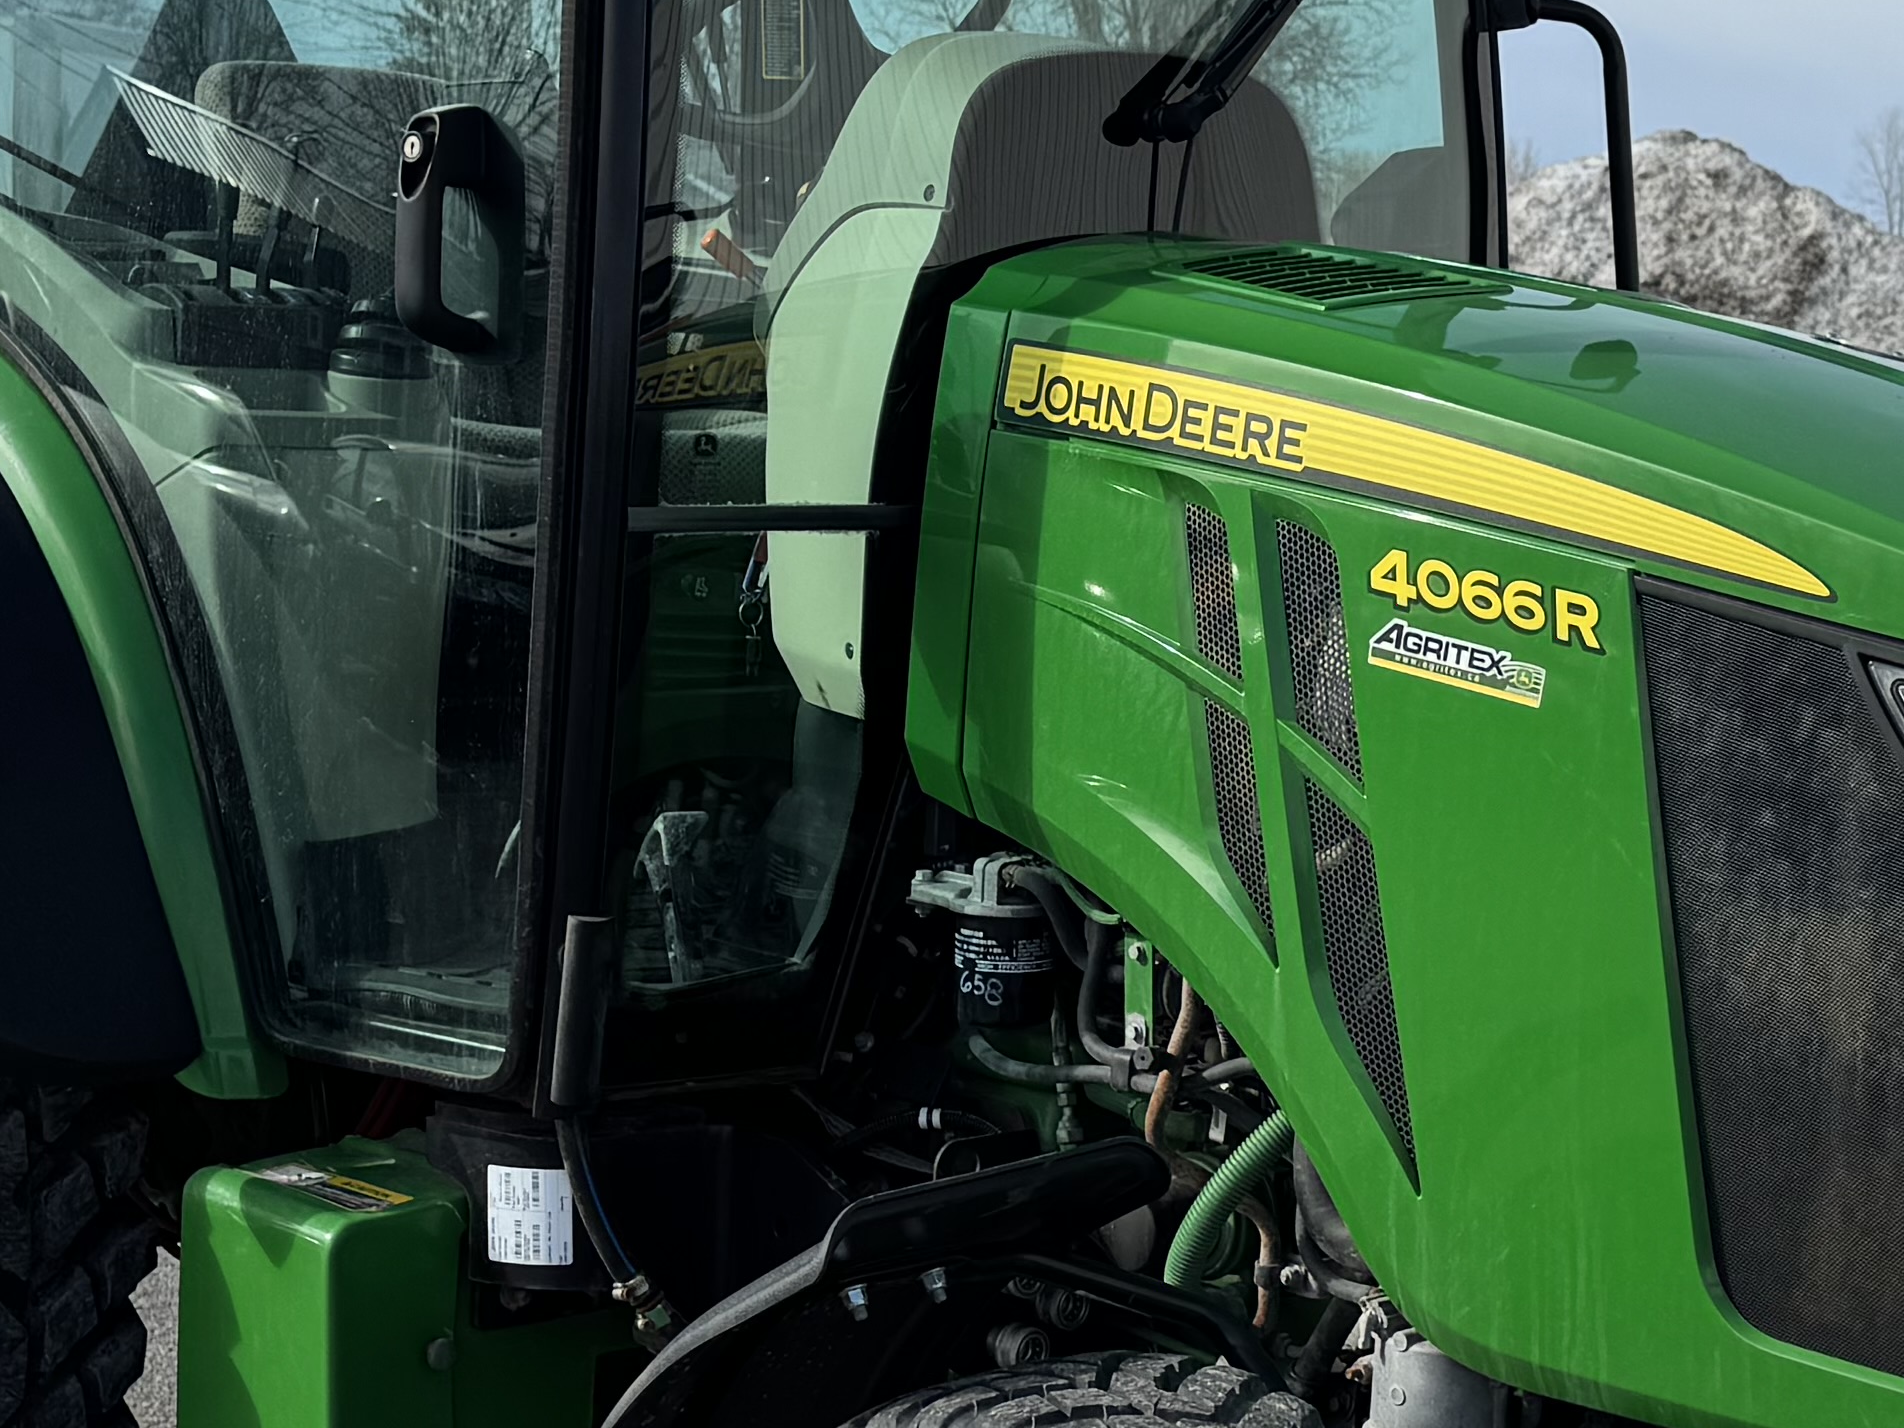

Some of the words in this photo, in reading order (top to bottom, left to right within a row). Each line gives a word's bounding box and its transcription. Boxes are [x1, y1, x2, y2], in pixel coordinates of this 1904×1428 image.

[1018, 363, 1135, 429] JOHN
[1142, 381, 1308, 465] DEERE
[1372, 622, 1508, 676] AGRITEX
[959, 970, 1004, 1006] 658
